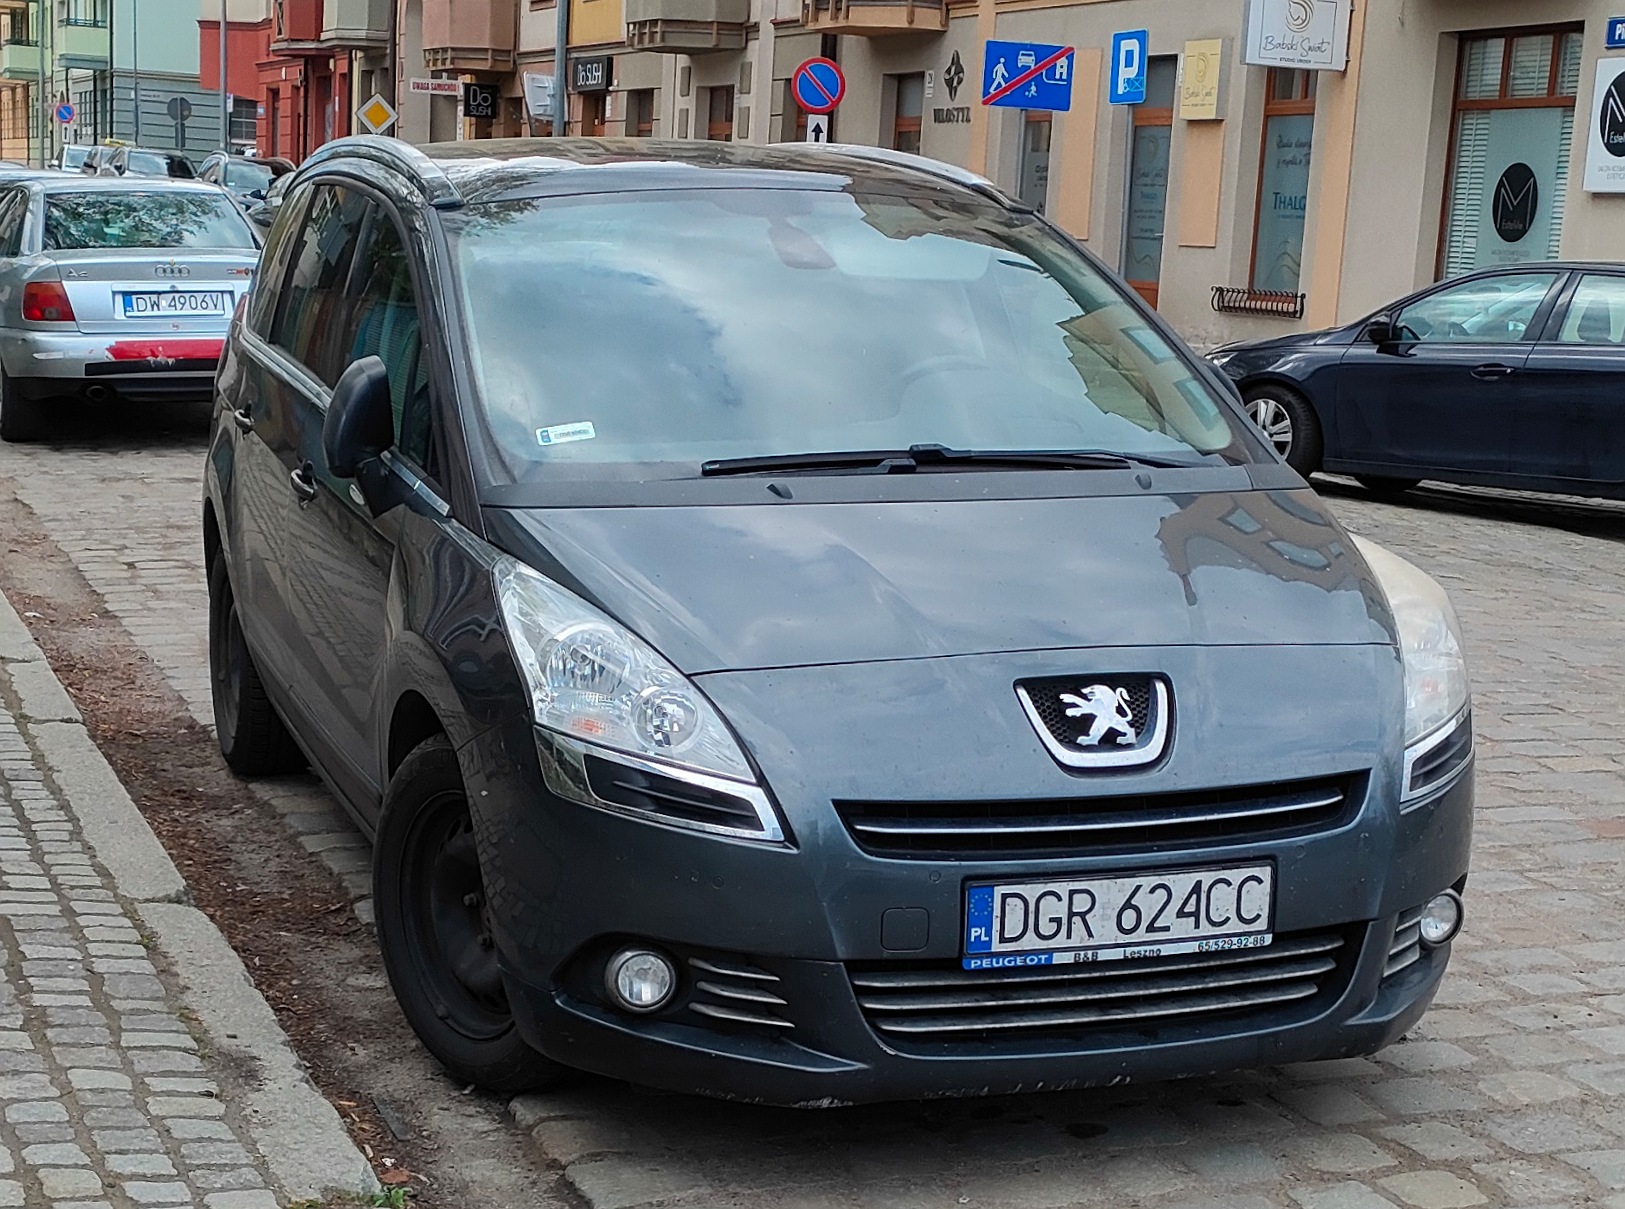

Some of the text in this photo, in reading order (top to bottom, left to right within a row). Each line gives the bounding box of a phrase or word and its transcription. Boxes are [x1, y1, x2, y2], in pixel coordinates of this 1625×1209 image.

[1263, 34, 1299, 51] Babski
[1117, 39, 1140, 95] P
[135, 294, 219, 312] DW 4906V
[999, 875, 1264, 944] DGR 624CC
[970, 927, 989, 942] PL
[970, 936, 1266, 969] PEUGEOT B&B Leszno 65/529-92-88
